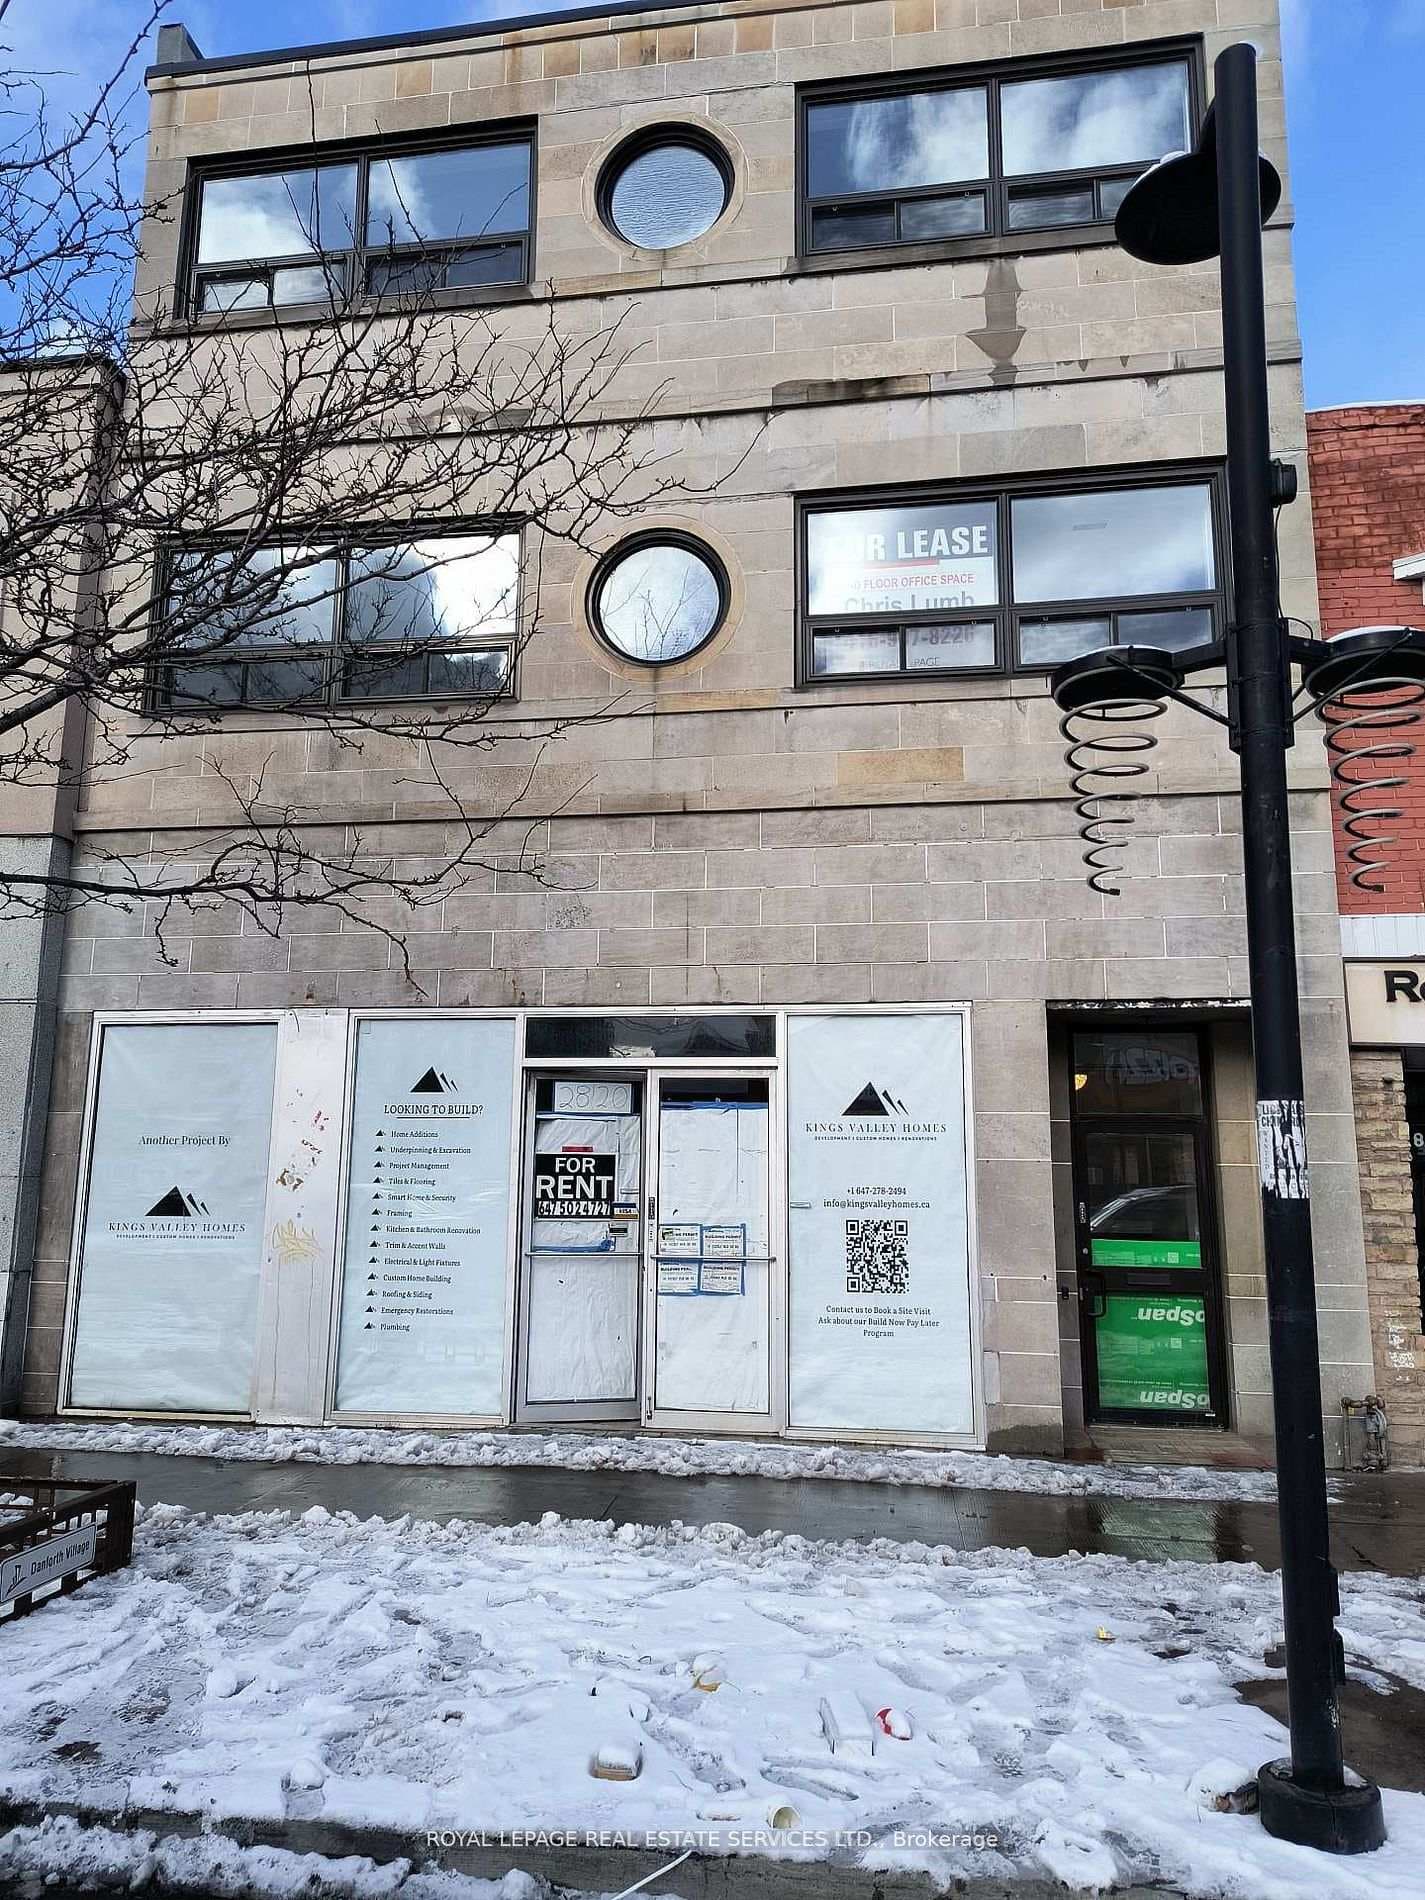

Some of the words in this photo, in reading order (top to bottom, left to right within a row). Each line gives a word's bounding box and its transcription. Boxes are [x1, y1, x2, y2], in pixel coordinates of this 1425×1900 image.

[897, 524, 988, 560] LEASE
[863, 576, 898, 589] FLOOR
[899, 574, 937, 587] OFFICE
[940, 572, 975, 585] SPACE
[1384, 970, 1425, 1003] R
[558, 1084, 629, 1110] 2820
[384, 1104, 430, 1115] LOOKING
[431, 1104, 446, 1115] TO
[447, 1104, 484, 1116] BUILD?
[806, 1122, 844, 1133] KINGS
[849, 1122, 897, 1133] VALLEY
[902, 1122, 947, 1133] HOMES
[391, 1130, 409, 1138] Home
[139, 1135, 179, 1146] Another
[181, 1135, 216, 1148] Project
[218, 1135, 232, 1148] By
[554, 1157, 597, 1174] FOR
[536, 1175, 614, 1200] RENT
[387, 1193, 406, 1201] Smart
[387, 1209, 413, 1219] Framing
[109, 1221, 146, 1233] KINGS
[150, 1221, 198, 1233] VALLEY
[202, 1222, 247, 1234] HOMES
[386, 1225, 410, 1233] Kitchen
[385, 1241, 401, 1249] Trim
[384, 1257, 413, 1266] Electrical
[418, 1258, 435, 1267] Light
[383, 1273, 407, 1282] Custom
[825, 1304, 854, 1314] Contact
[864, 1306, 873, 1314] to
[873, 1306, 892, 1315] Book
[913, 1307, 932, 1316] Visit
[818, 1316, 832, 1325] Ask
[832, 1316, 853, 1325] about
[853, 1318, 867, 1326] our
[888, 1318, 906, 1327] Now
[863, 1329, 895, 1339] Program
[31, 1552, 64, 1575] Danforth
[65, 1540, 90, 1558] Village
